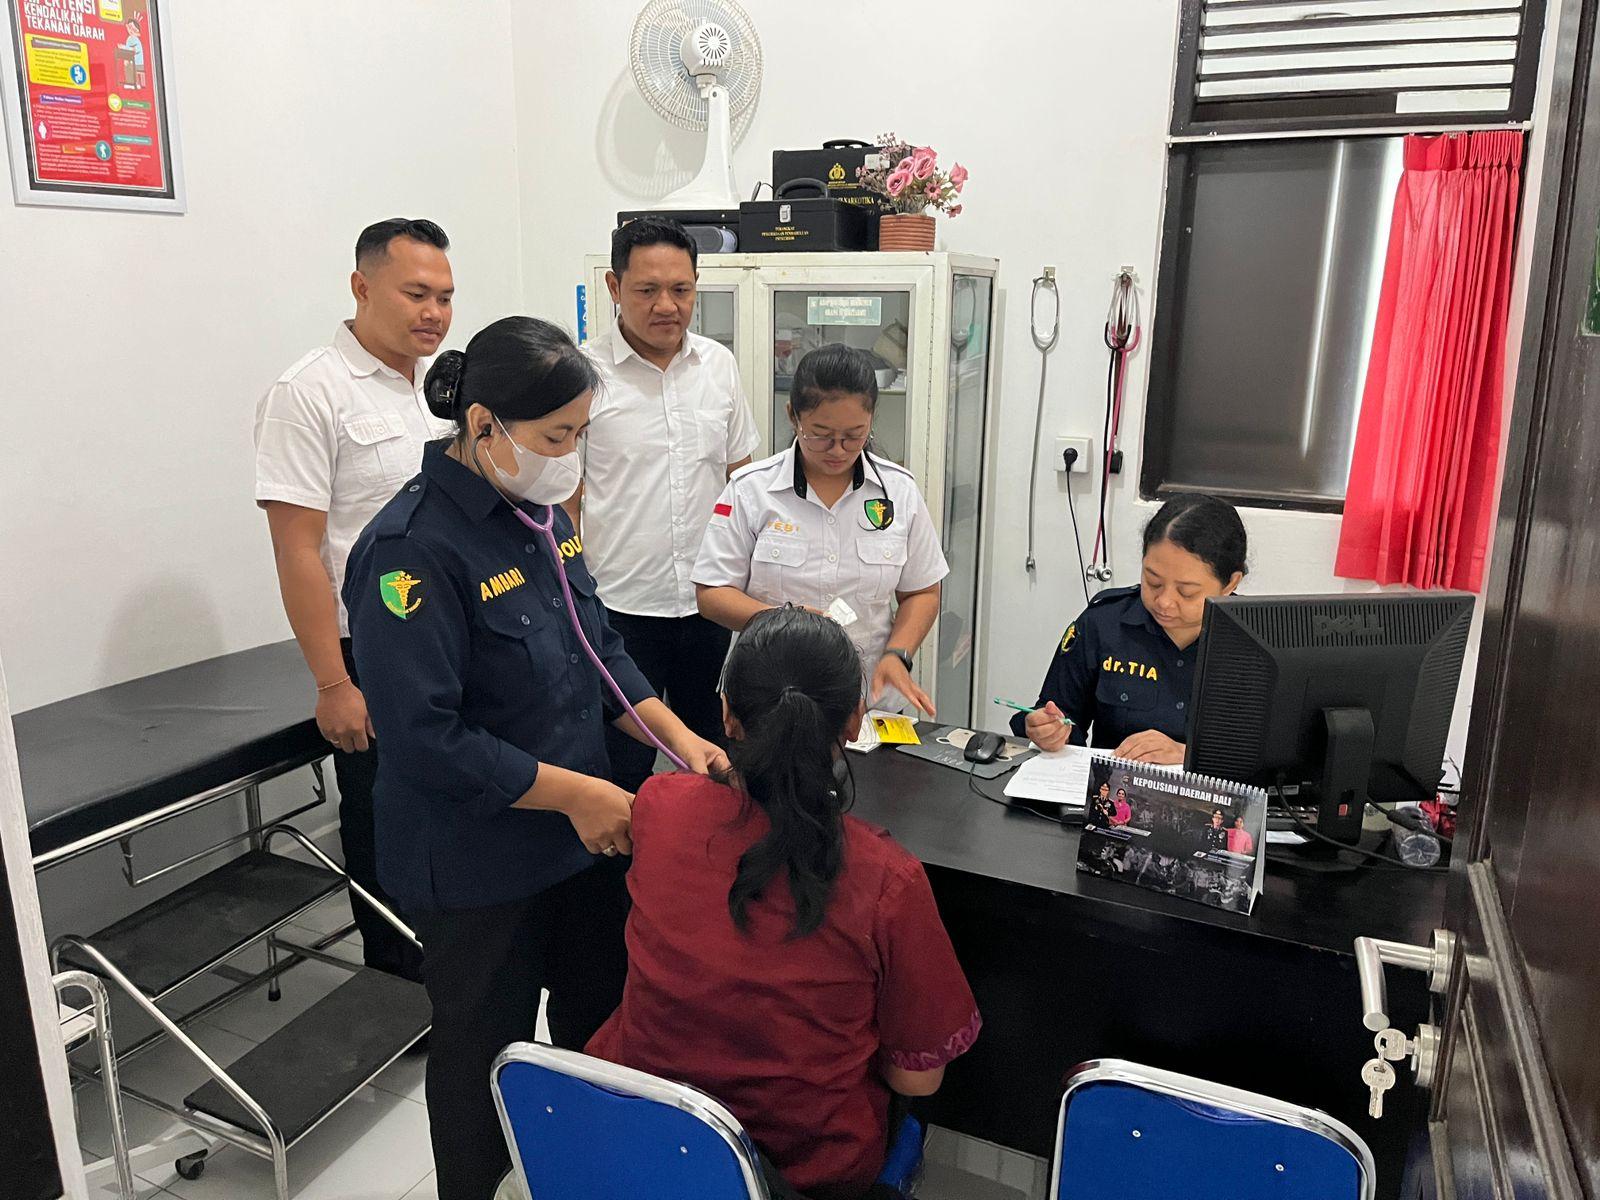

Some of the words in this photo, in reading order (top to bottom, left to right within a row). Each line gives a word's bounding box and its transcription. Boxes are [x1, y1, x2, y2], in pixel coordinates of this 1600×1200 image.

[24, 2, 83, 24] KENDALIKAN
[25, 15, 71, 35] TEKANAN
[73, 24, 105, 40] DARAH
[480, 567, 526, 602] AMBARI
[1132, 776, 1179, 795] KEPOLISIAN
[1179, 786, 1212, 802] DAERAH
[1212, 793, 1232, 807] BALI
